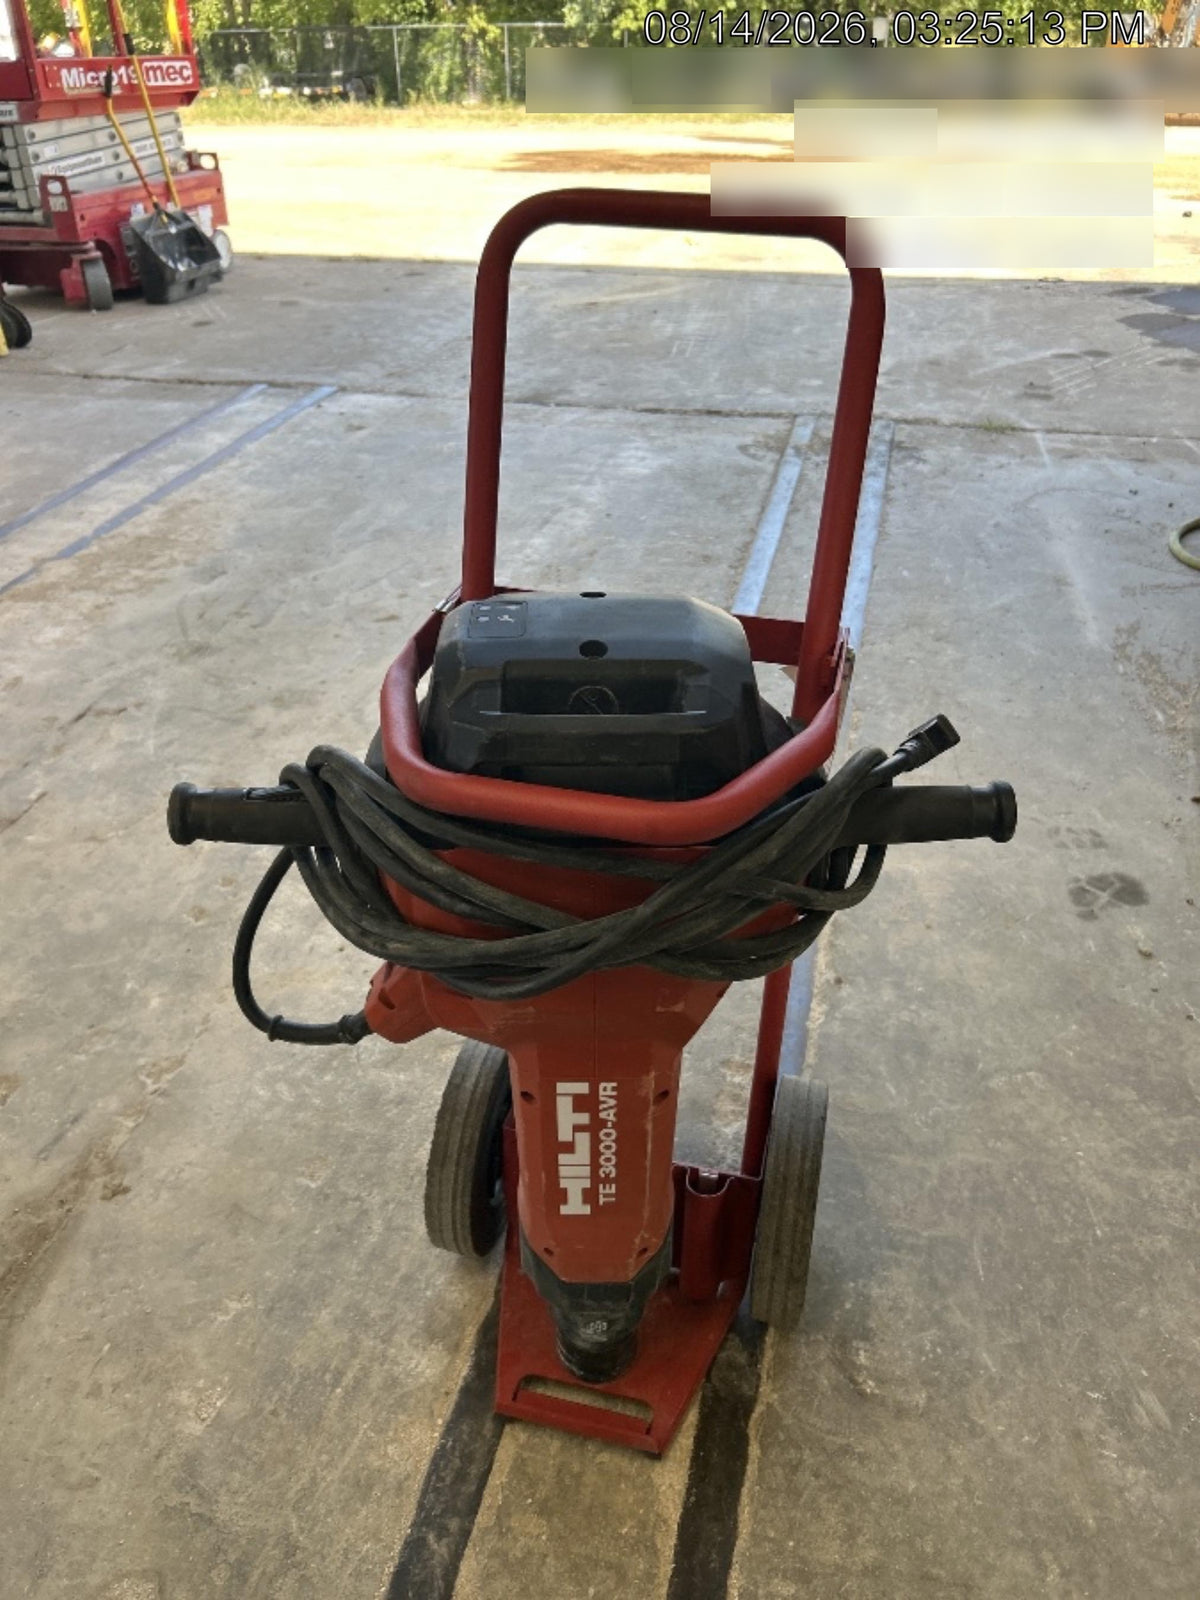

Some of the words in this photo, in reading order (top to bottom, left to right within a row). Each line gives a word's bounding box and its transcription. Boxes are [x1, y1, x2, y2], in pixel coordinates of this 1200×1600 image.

[556, 1082, 591, 1215] HILTI
[598, 1082, 618, 1178] 3000-AVR
[598, 1183, 616, 1206] TE
